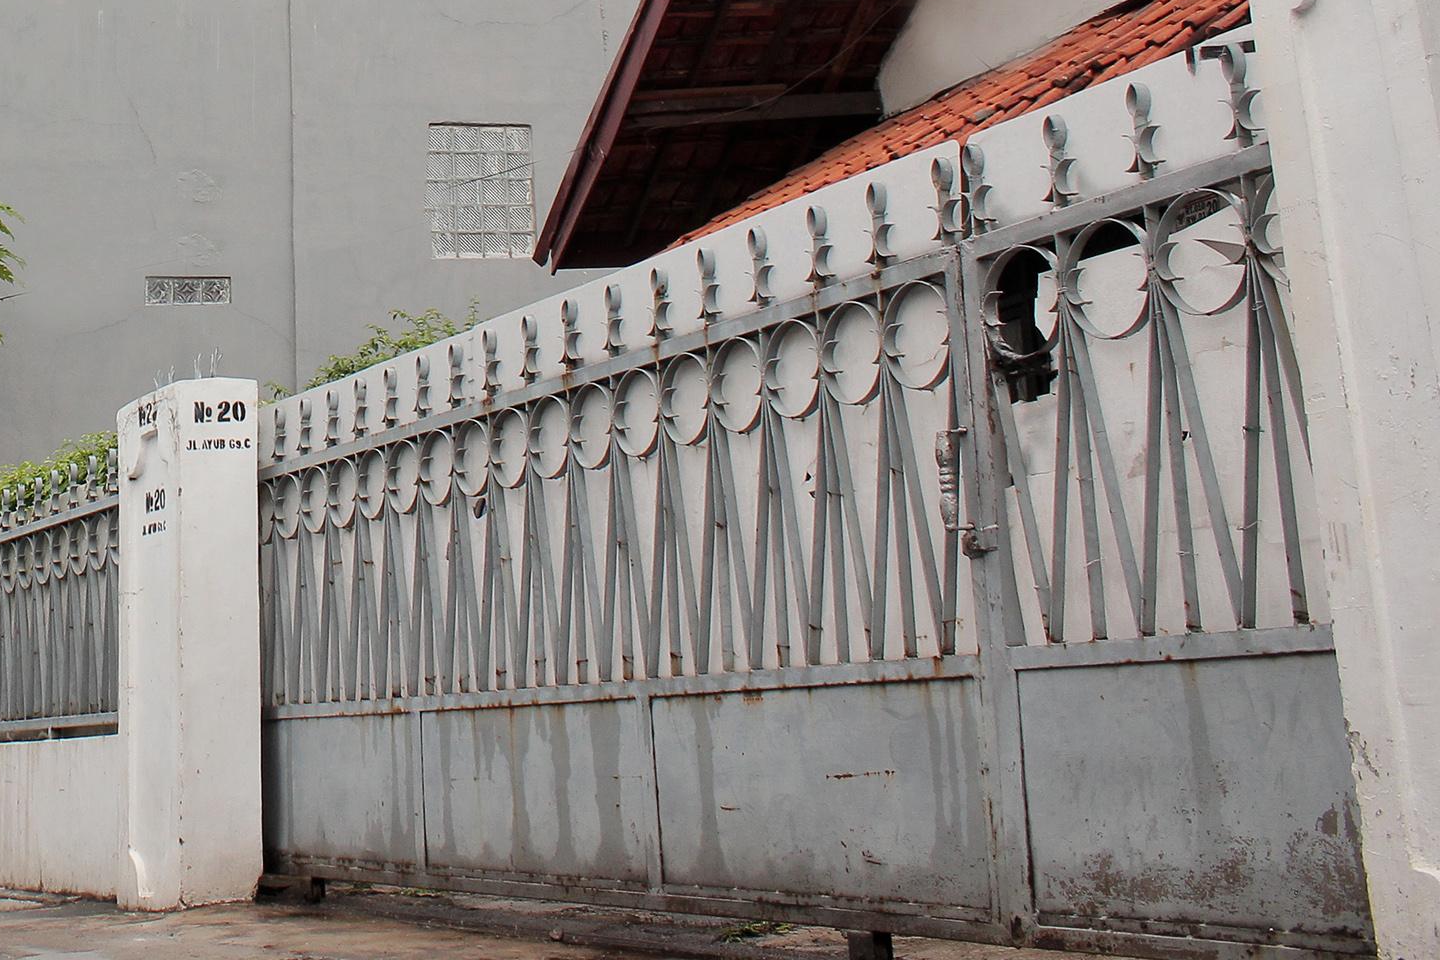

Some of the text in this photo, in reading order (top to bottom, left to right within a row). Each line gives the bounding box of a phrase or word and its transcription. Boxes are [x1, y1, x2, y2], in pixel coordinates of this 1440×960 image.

[217, 401, 246, 422] 20
[202, 438, 226, 451] AYUB
[154, 488, 165, 512] 20
